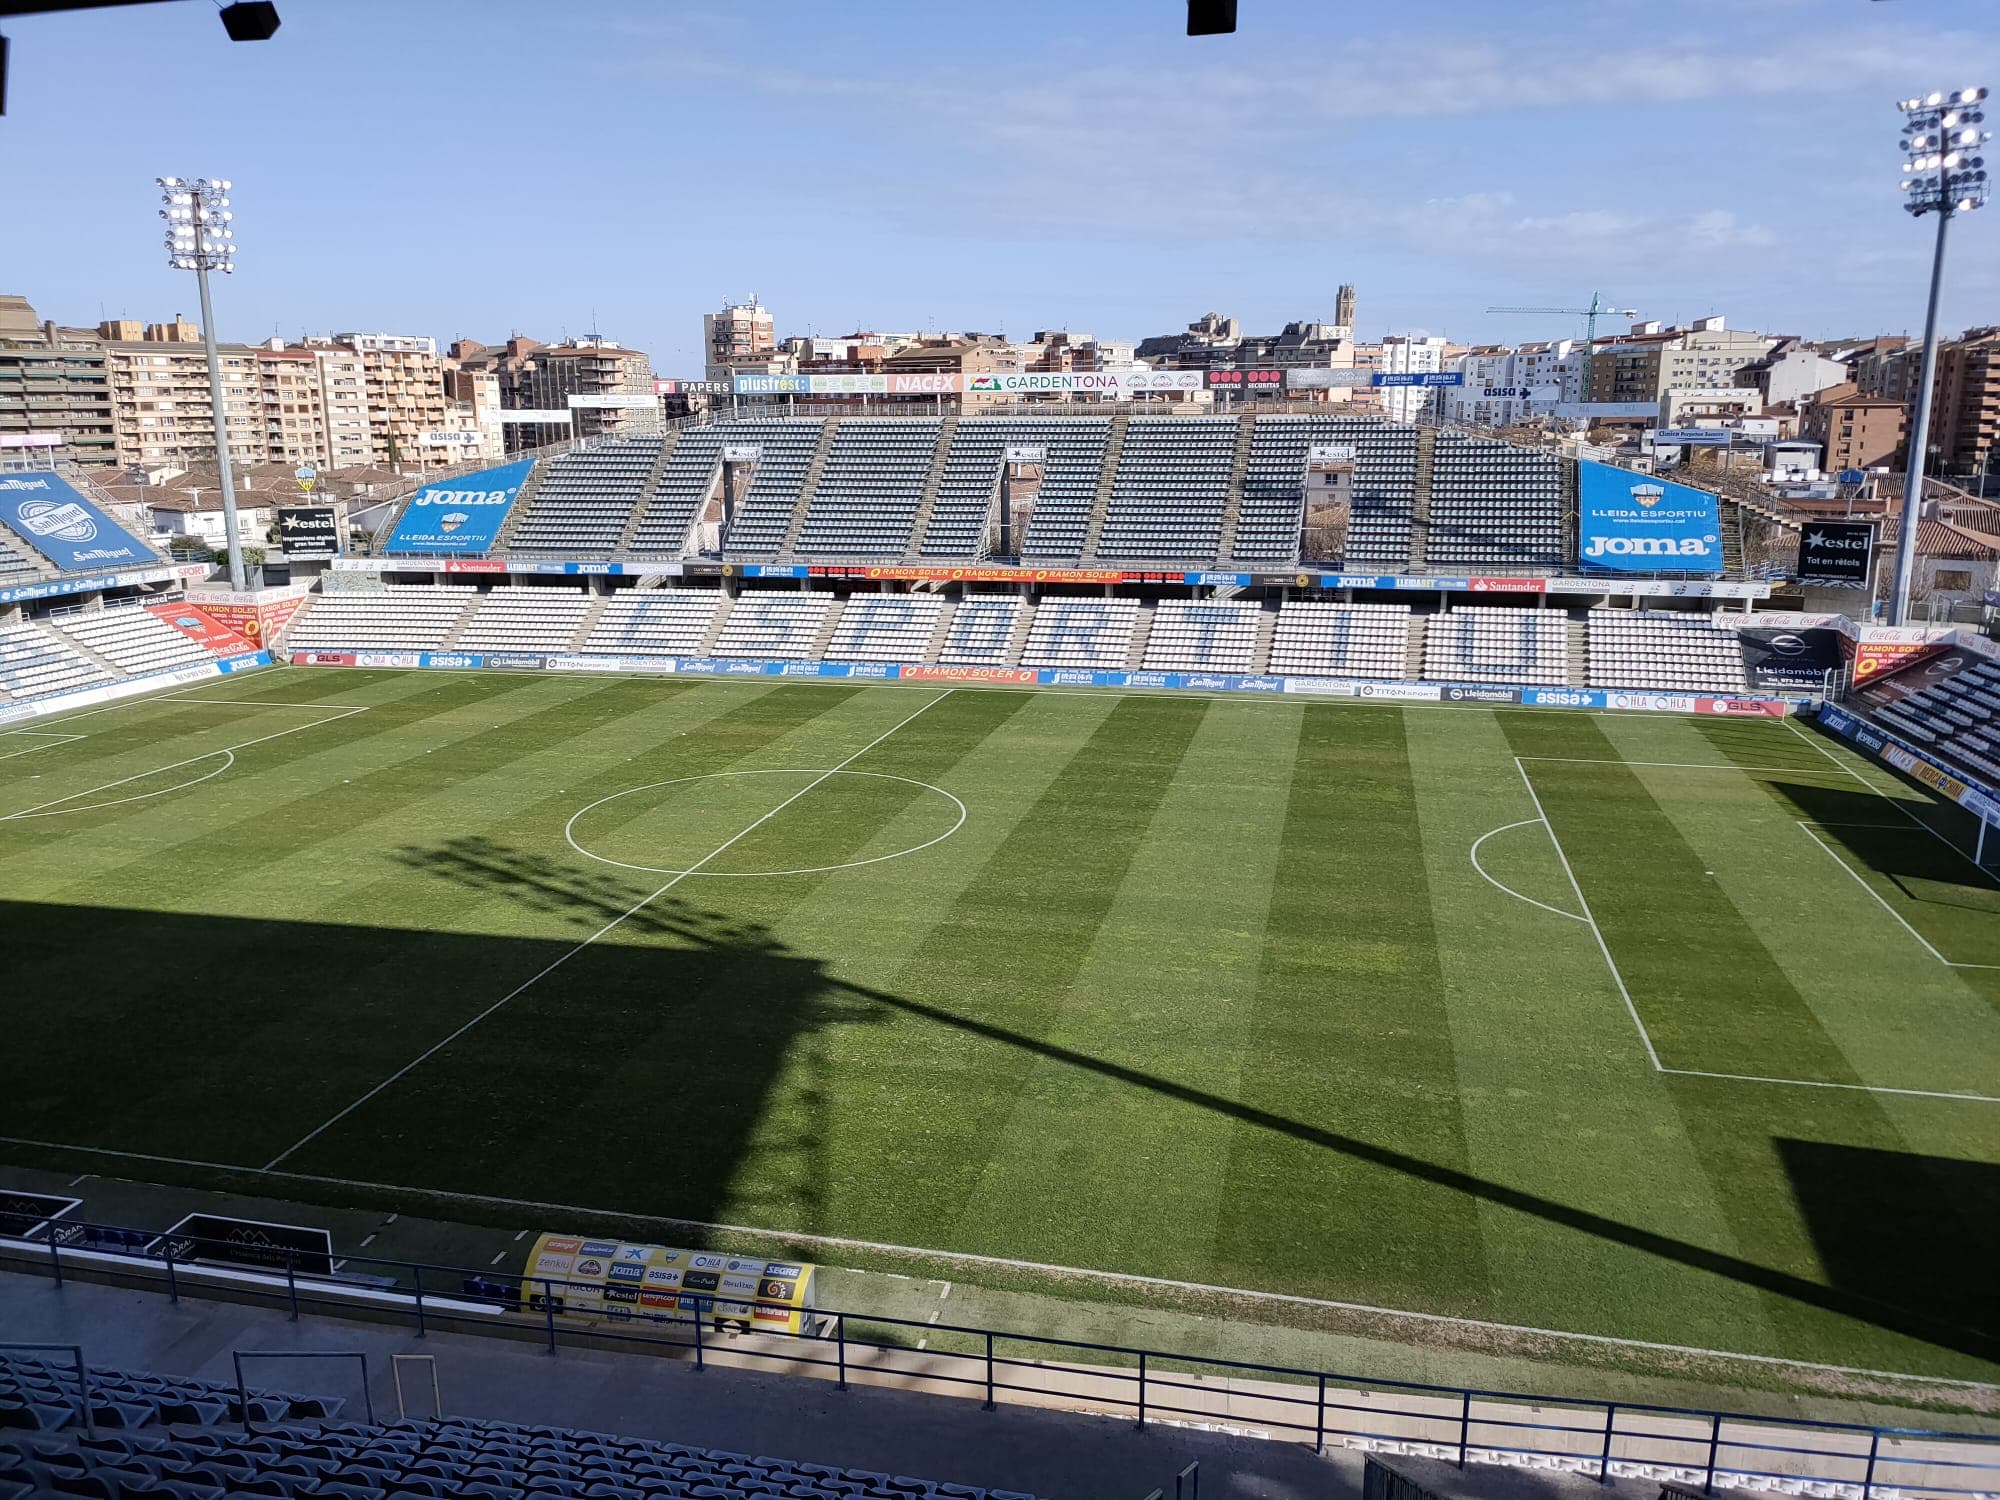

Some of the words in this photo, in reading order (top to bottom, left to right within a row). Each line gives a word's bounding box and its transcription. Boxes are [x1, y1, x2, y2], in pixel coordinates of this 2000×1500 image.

[681, 383, 729, 392] PAPERS
[895, 376, 956, 391] NACEX
[1006, 376, 1118, 389] GARDENTONA
[1484, 388, 1516, 398] asisa
[430, 432, 461, 441] asisa
[1592, 510, 1638, 518] LLEIDA
[300, 518, 335, 528] estel
[1825, 537, 1868, 550] estel
[1806, 556, 1820, 564] Tot
[177, 563, 206, 578] SPORT
[462, 562, 502, 573] Santander
[883, 568, 908, 576] RAMON
[1490, 582, 1541, 592] Santander
[1552, 580, 1610, 588] GARDENTONA
[146, 594, 168, 605] estel
[282, 600, 299, 608] SOLER
[202, 606, 230, 614] RAMON
[374, 656, 386, 664] HLA
[402, 657, 414, 665] HLA
[430, 657, 463, 666] asisa
[923, 667, 968, 676] RAMON
[971, 669, 1014, 678] SOLER
[1536, 692, 1580, 704] asisa
[1630, 696, 1647, 708] HLA
[1670, 697, 1686, 709] HLA
[1728, 702, 1761, 711] GLS
[538, 1258, 569, 1268] zenkiu
[706, 1258, 720, 1266] HLA
[648, 1270, 672, 1280] asisa
[766, 1266, 799, 1276] SEGRE
[614, 1290, 638, 1300] estel
